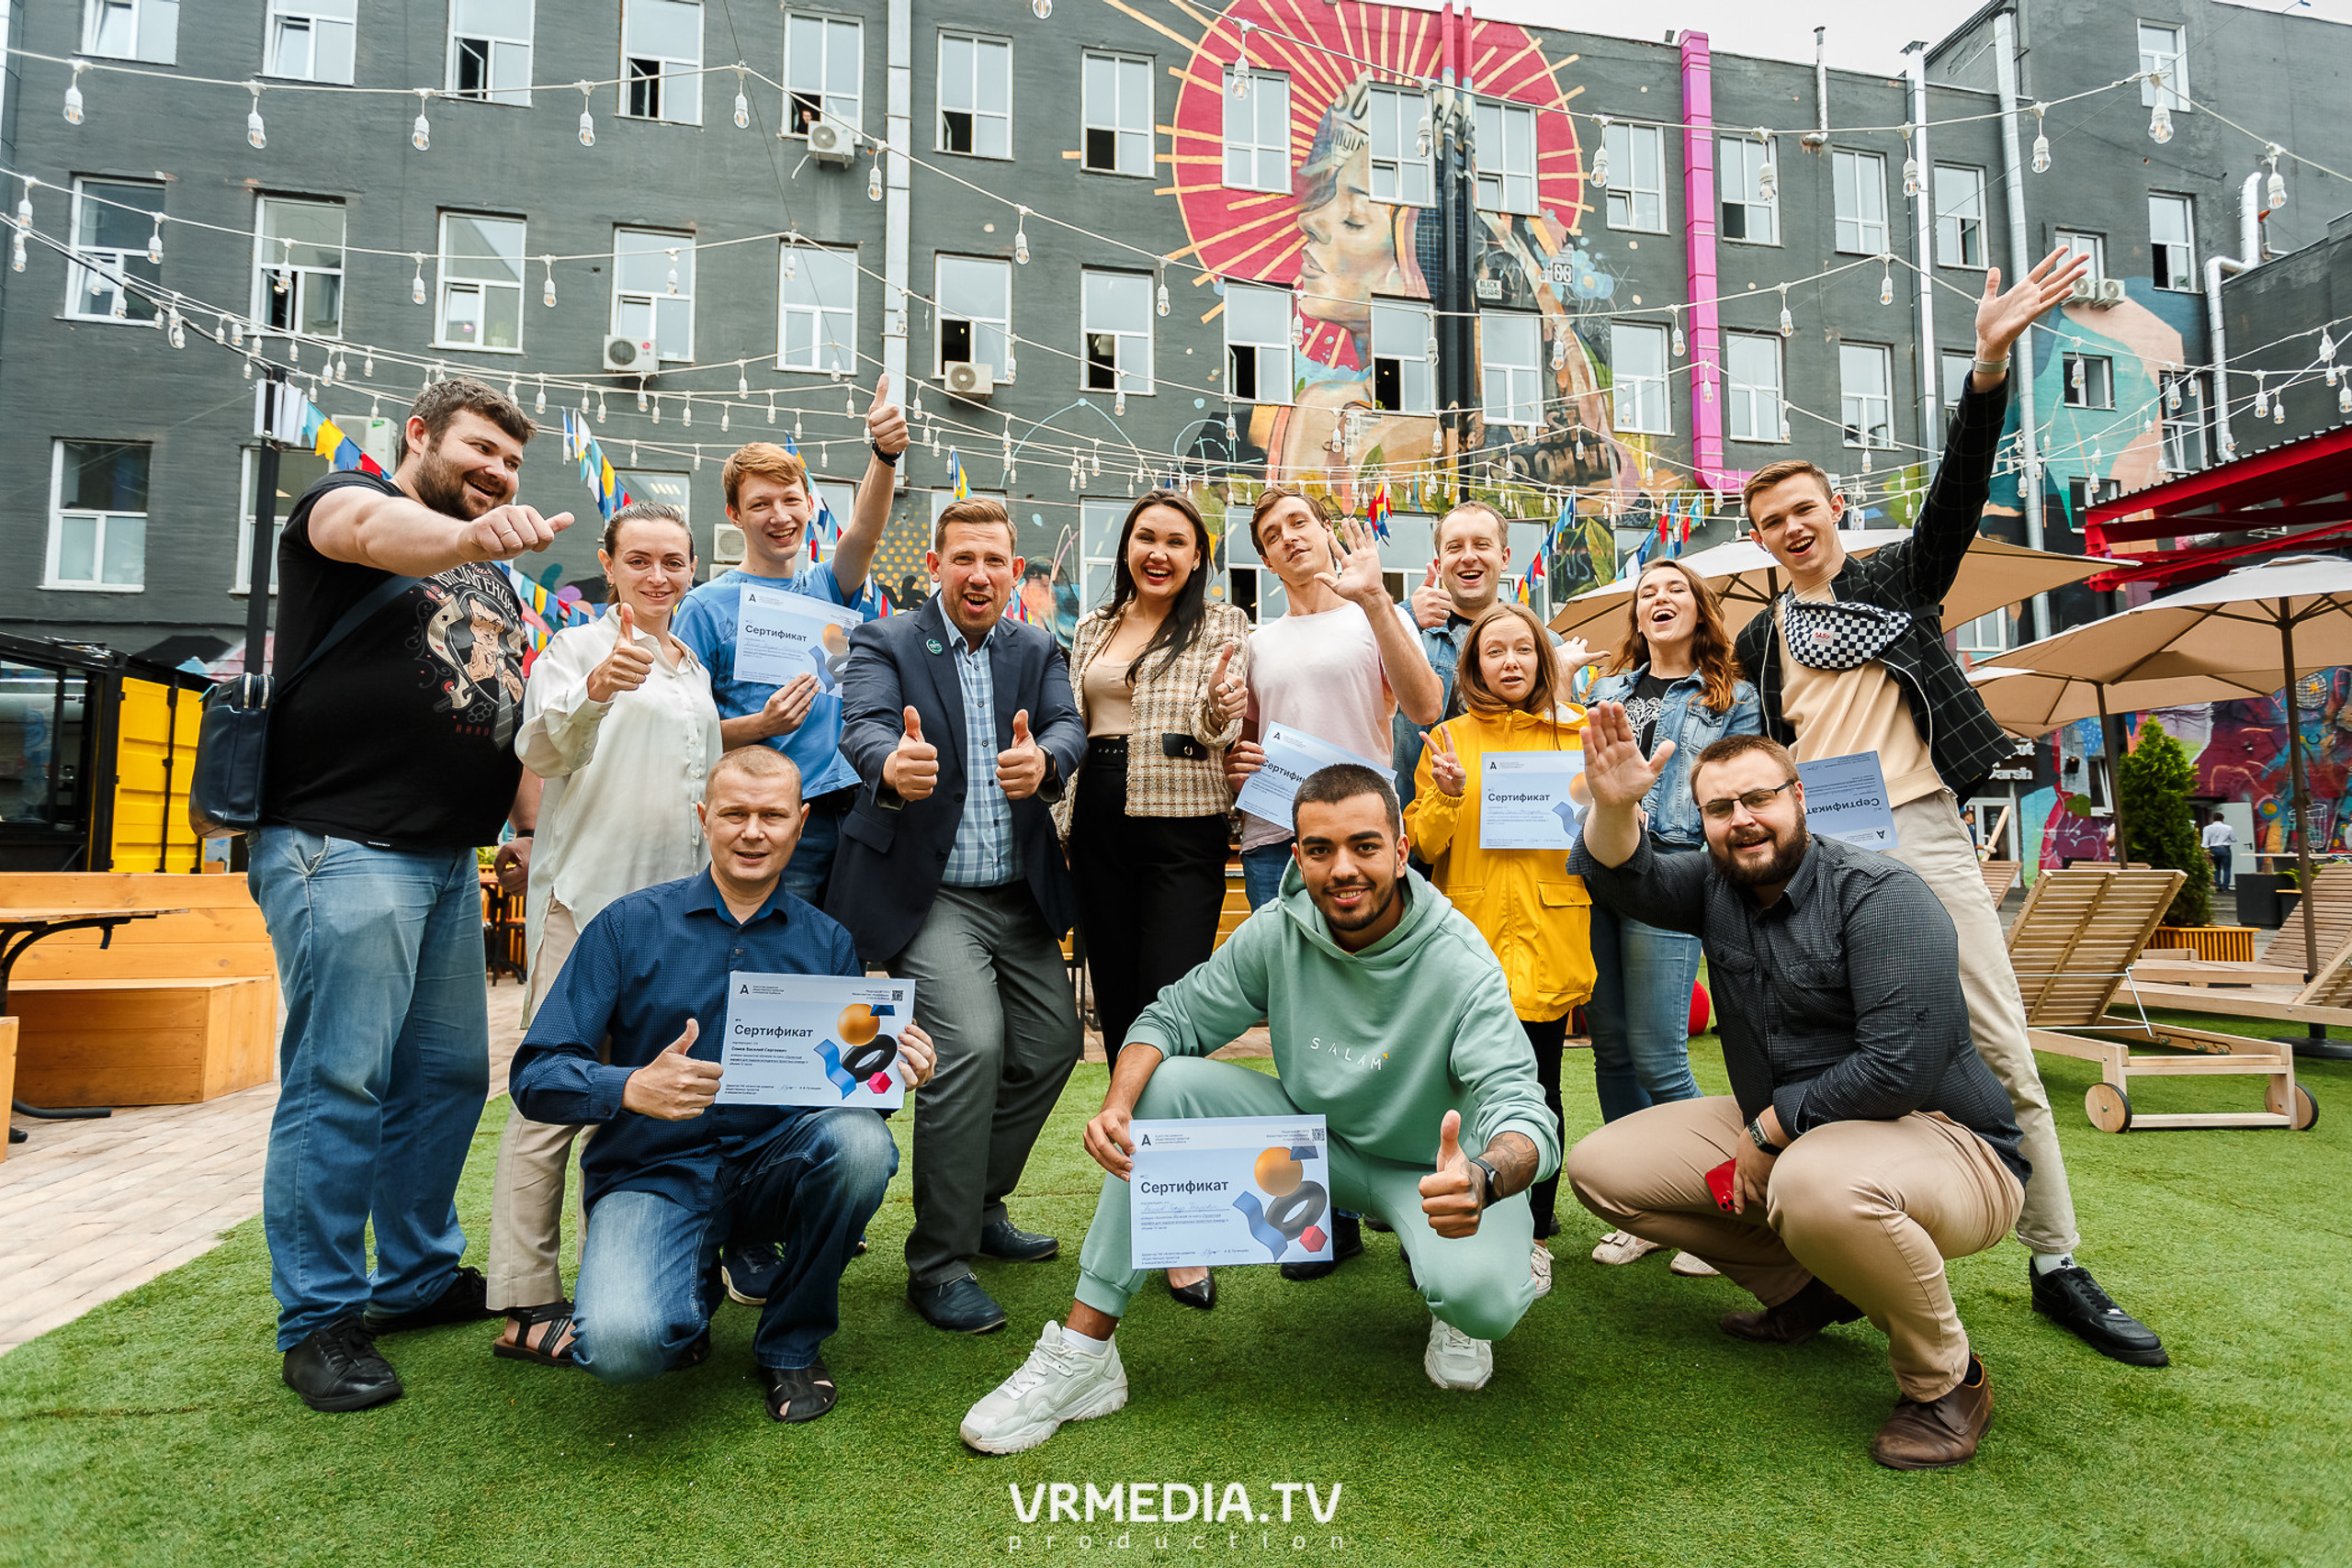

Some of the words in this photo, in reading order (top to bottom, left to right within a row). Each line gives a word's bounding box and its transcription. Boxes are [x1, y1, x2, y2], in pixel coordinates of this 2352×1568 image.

[745, 625, 808, 642] Сертификат
[1487, 793, 1551, 804] Сертификат
[1805, 798, 1880, 815] Сертификат
[735, 1024, 814, 1039] Сертификат
[1310, 1037, 1383, 1071] SALAM
[1141, 1179, 1229, 1196] Сертификат
